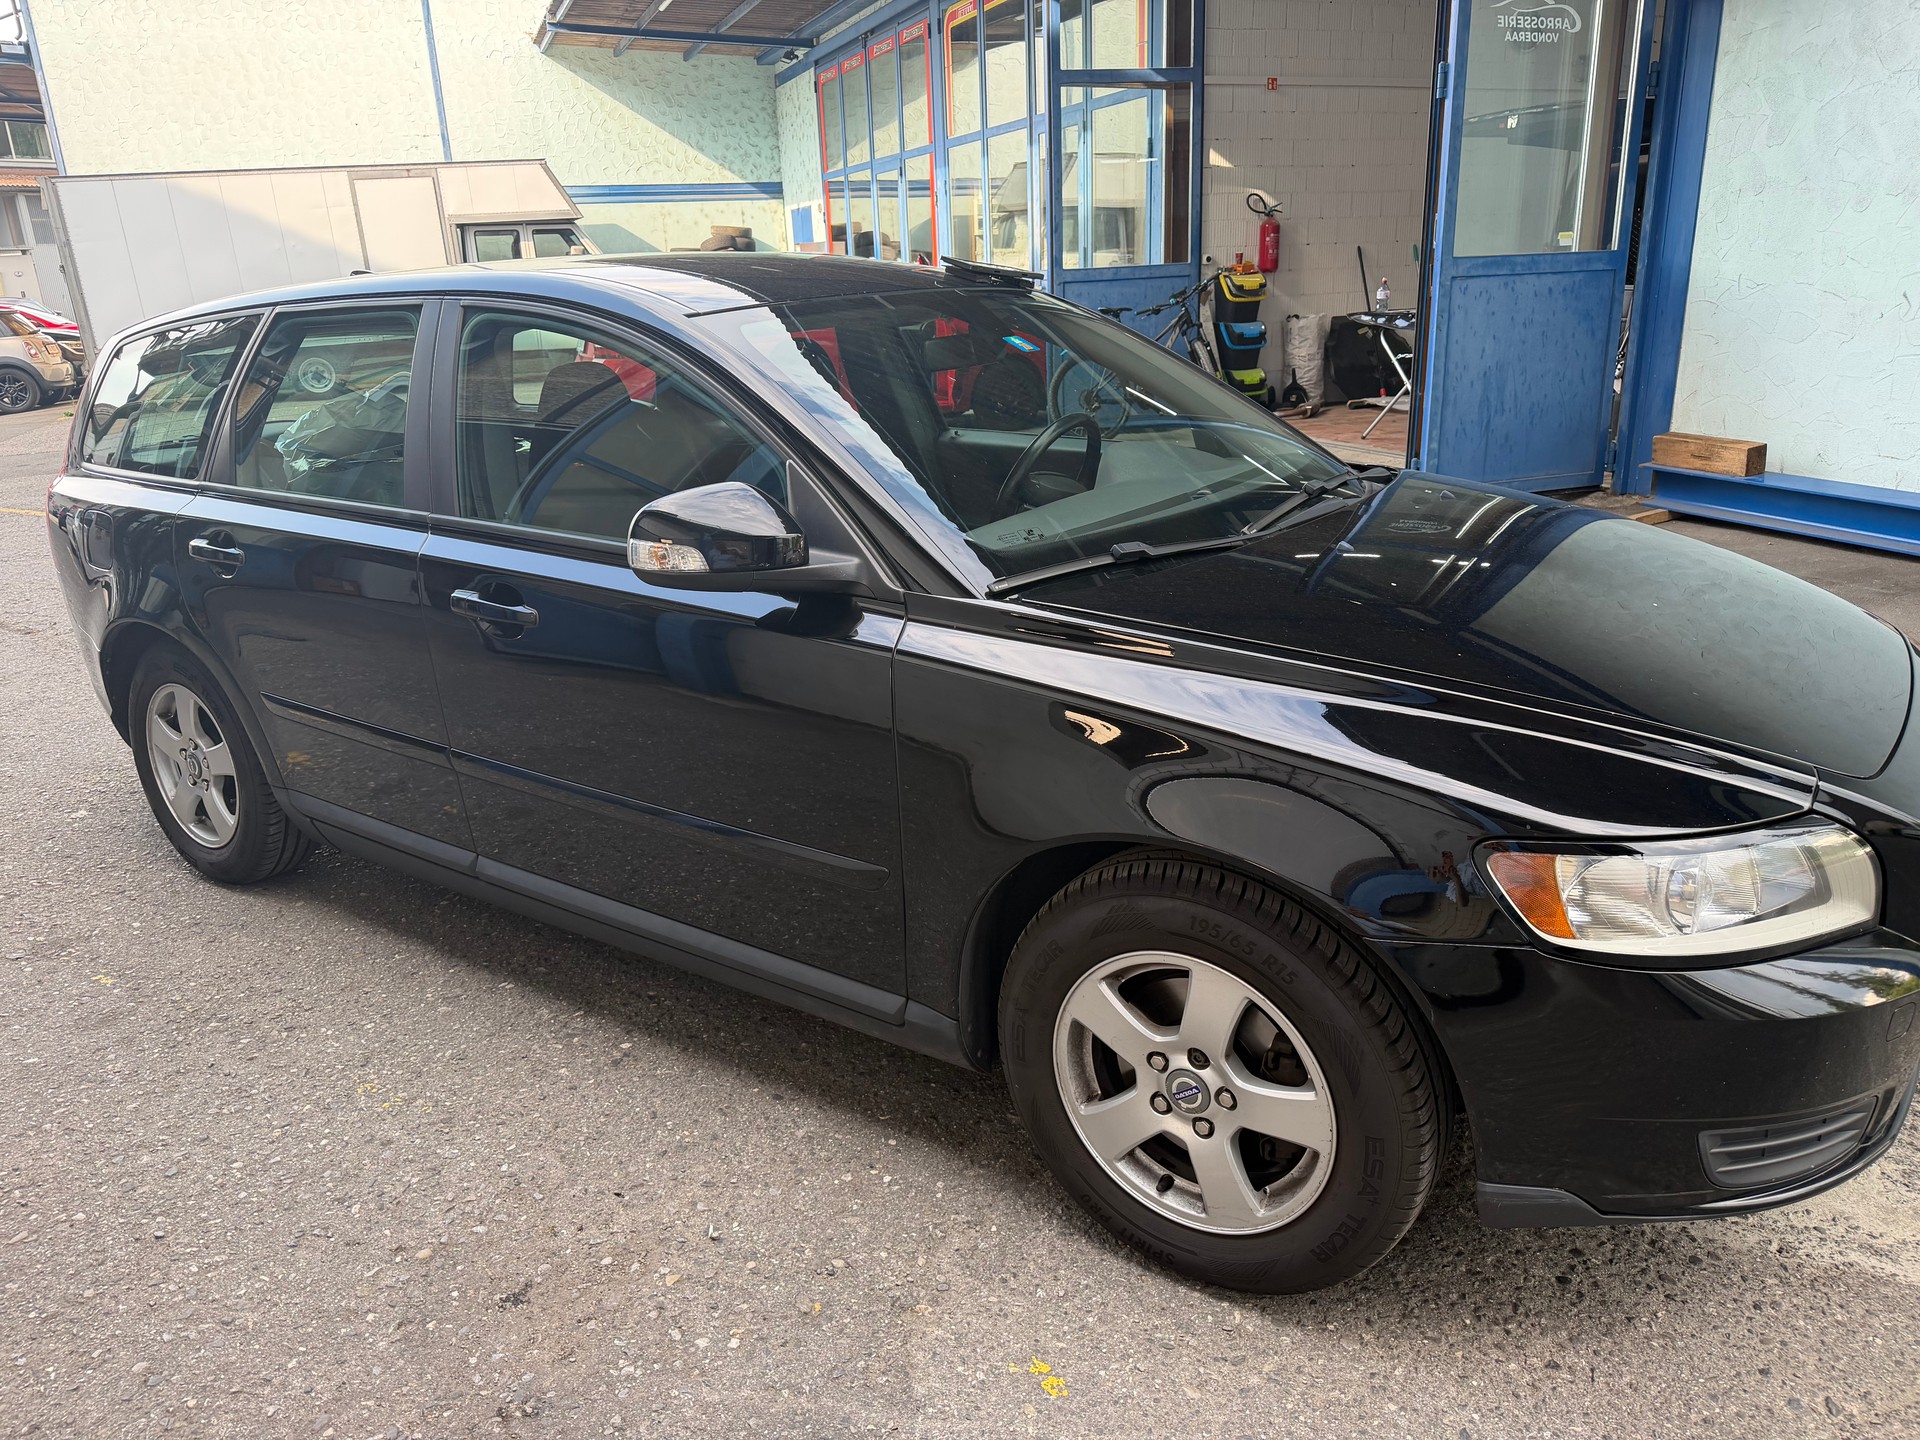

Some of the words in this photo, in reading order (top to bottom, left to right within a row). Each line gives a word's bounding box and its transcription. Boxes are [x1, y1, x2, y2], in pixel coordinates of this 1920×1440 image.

[1189, 915, 1258, 956] 195/65
[1260, 953, 1299, 985] R15
[1174, 1088, 1200, 1099] VOLVO
[1309, 1213, 1368, 1264] TECAR
